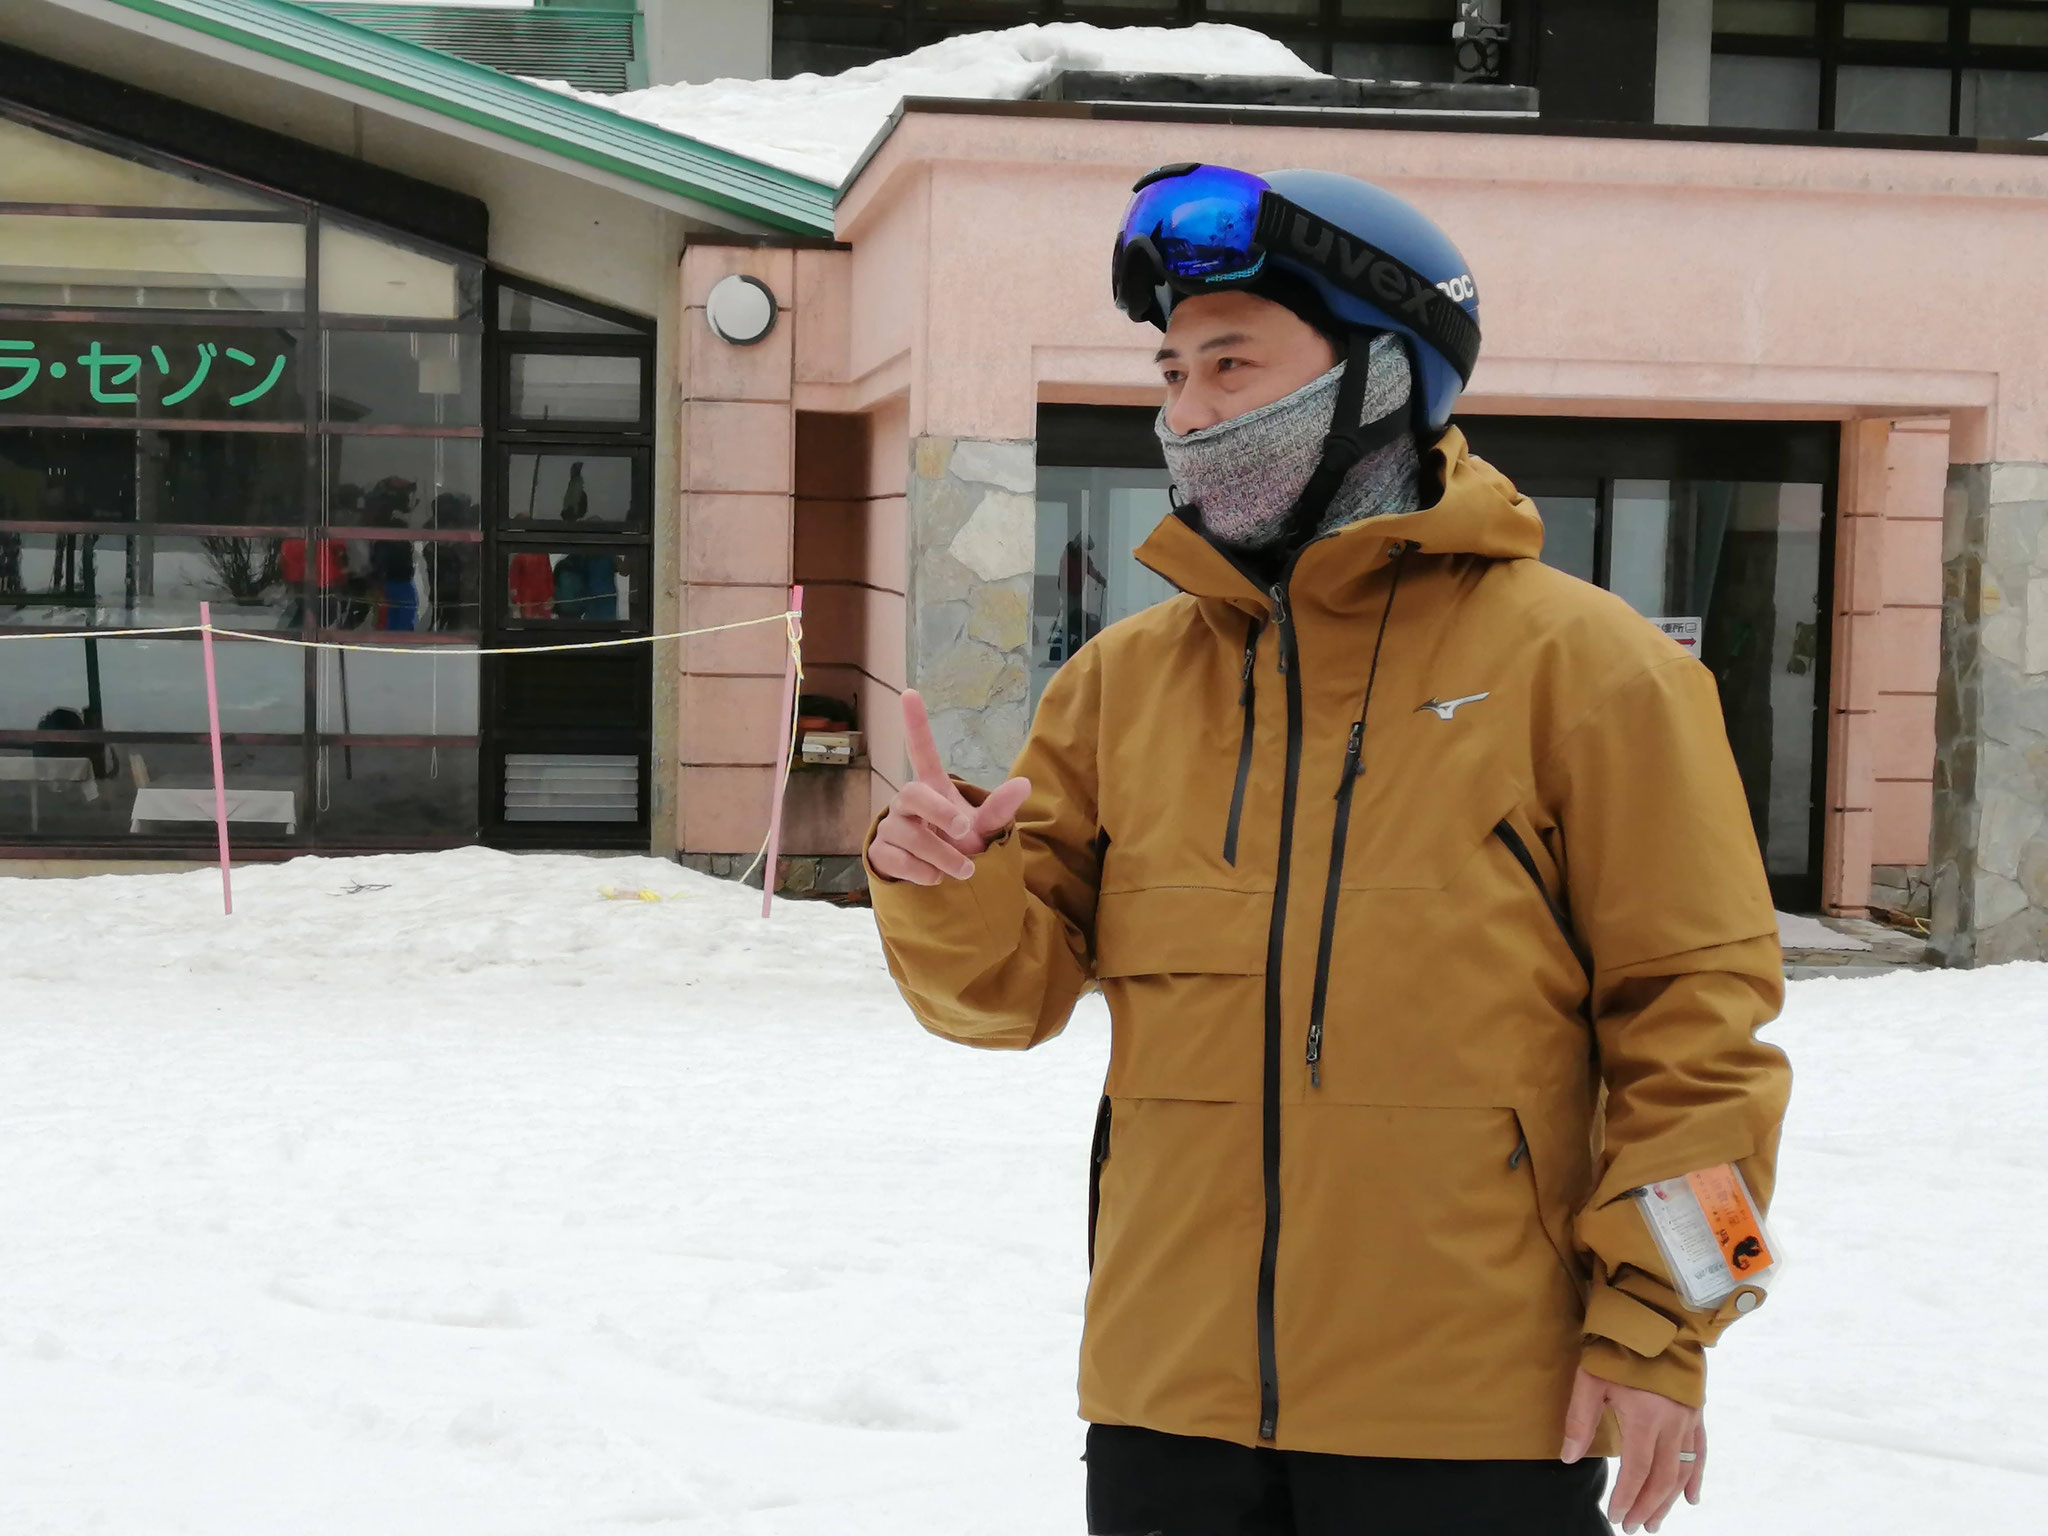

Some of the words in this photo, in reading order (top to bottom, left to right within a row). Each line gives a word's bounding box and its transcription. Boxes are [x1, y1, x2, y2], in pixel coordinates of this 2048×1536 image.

[1290, 214, 1437, 326] uvex
[0, 340, 287, 406] ラ・セゾン
